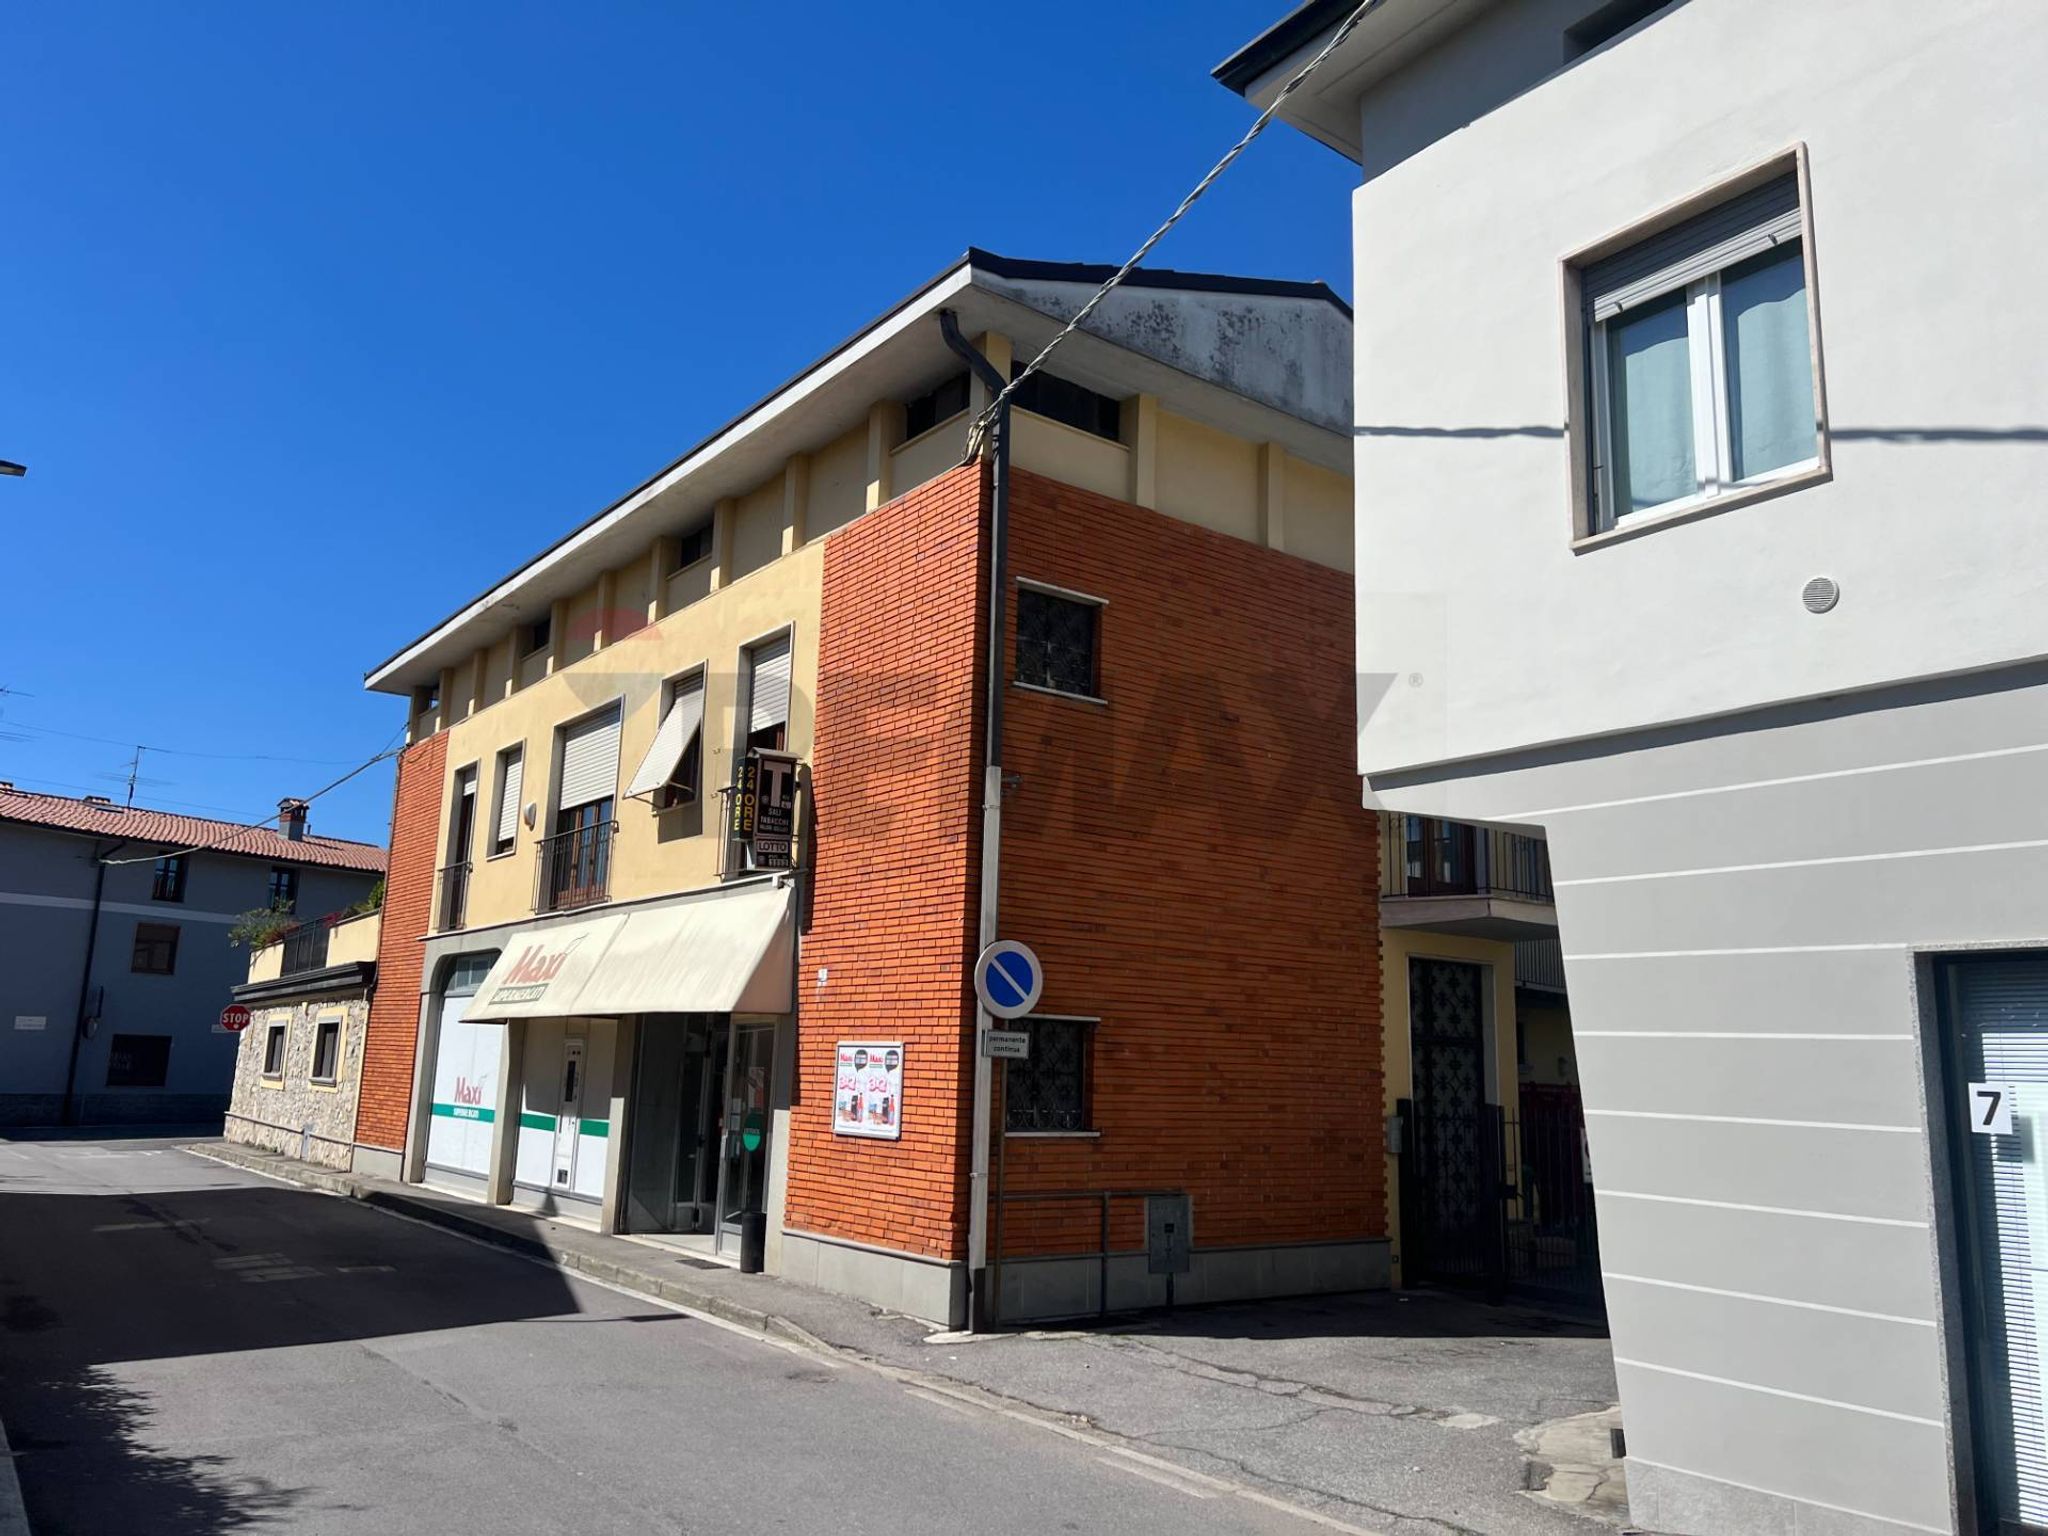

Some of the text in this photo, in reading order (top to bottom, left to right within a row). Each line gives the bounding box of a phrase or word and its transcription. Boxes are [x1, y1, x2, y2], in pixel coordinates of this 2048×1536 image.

[744, 767, 755, 831] 24 ORE
[764, 761, 792, 807] T
[734, 794, 742, 831] ORE
[758, 842, 787, 852] LOTTO
[503, 945, 567, 984] Maxi
[223, 1012, 249, 1024] STOP
[989, 1035, 1026, 1044] permanente
[454, 1076, 482, 1105] Maxi
[1976, 1091, 2001, 1126] 7
